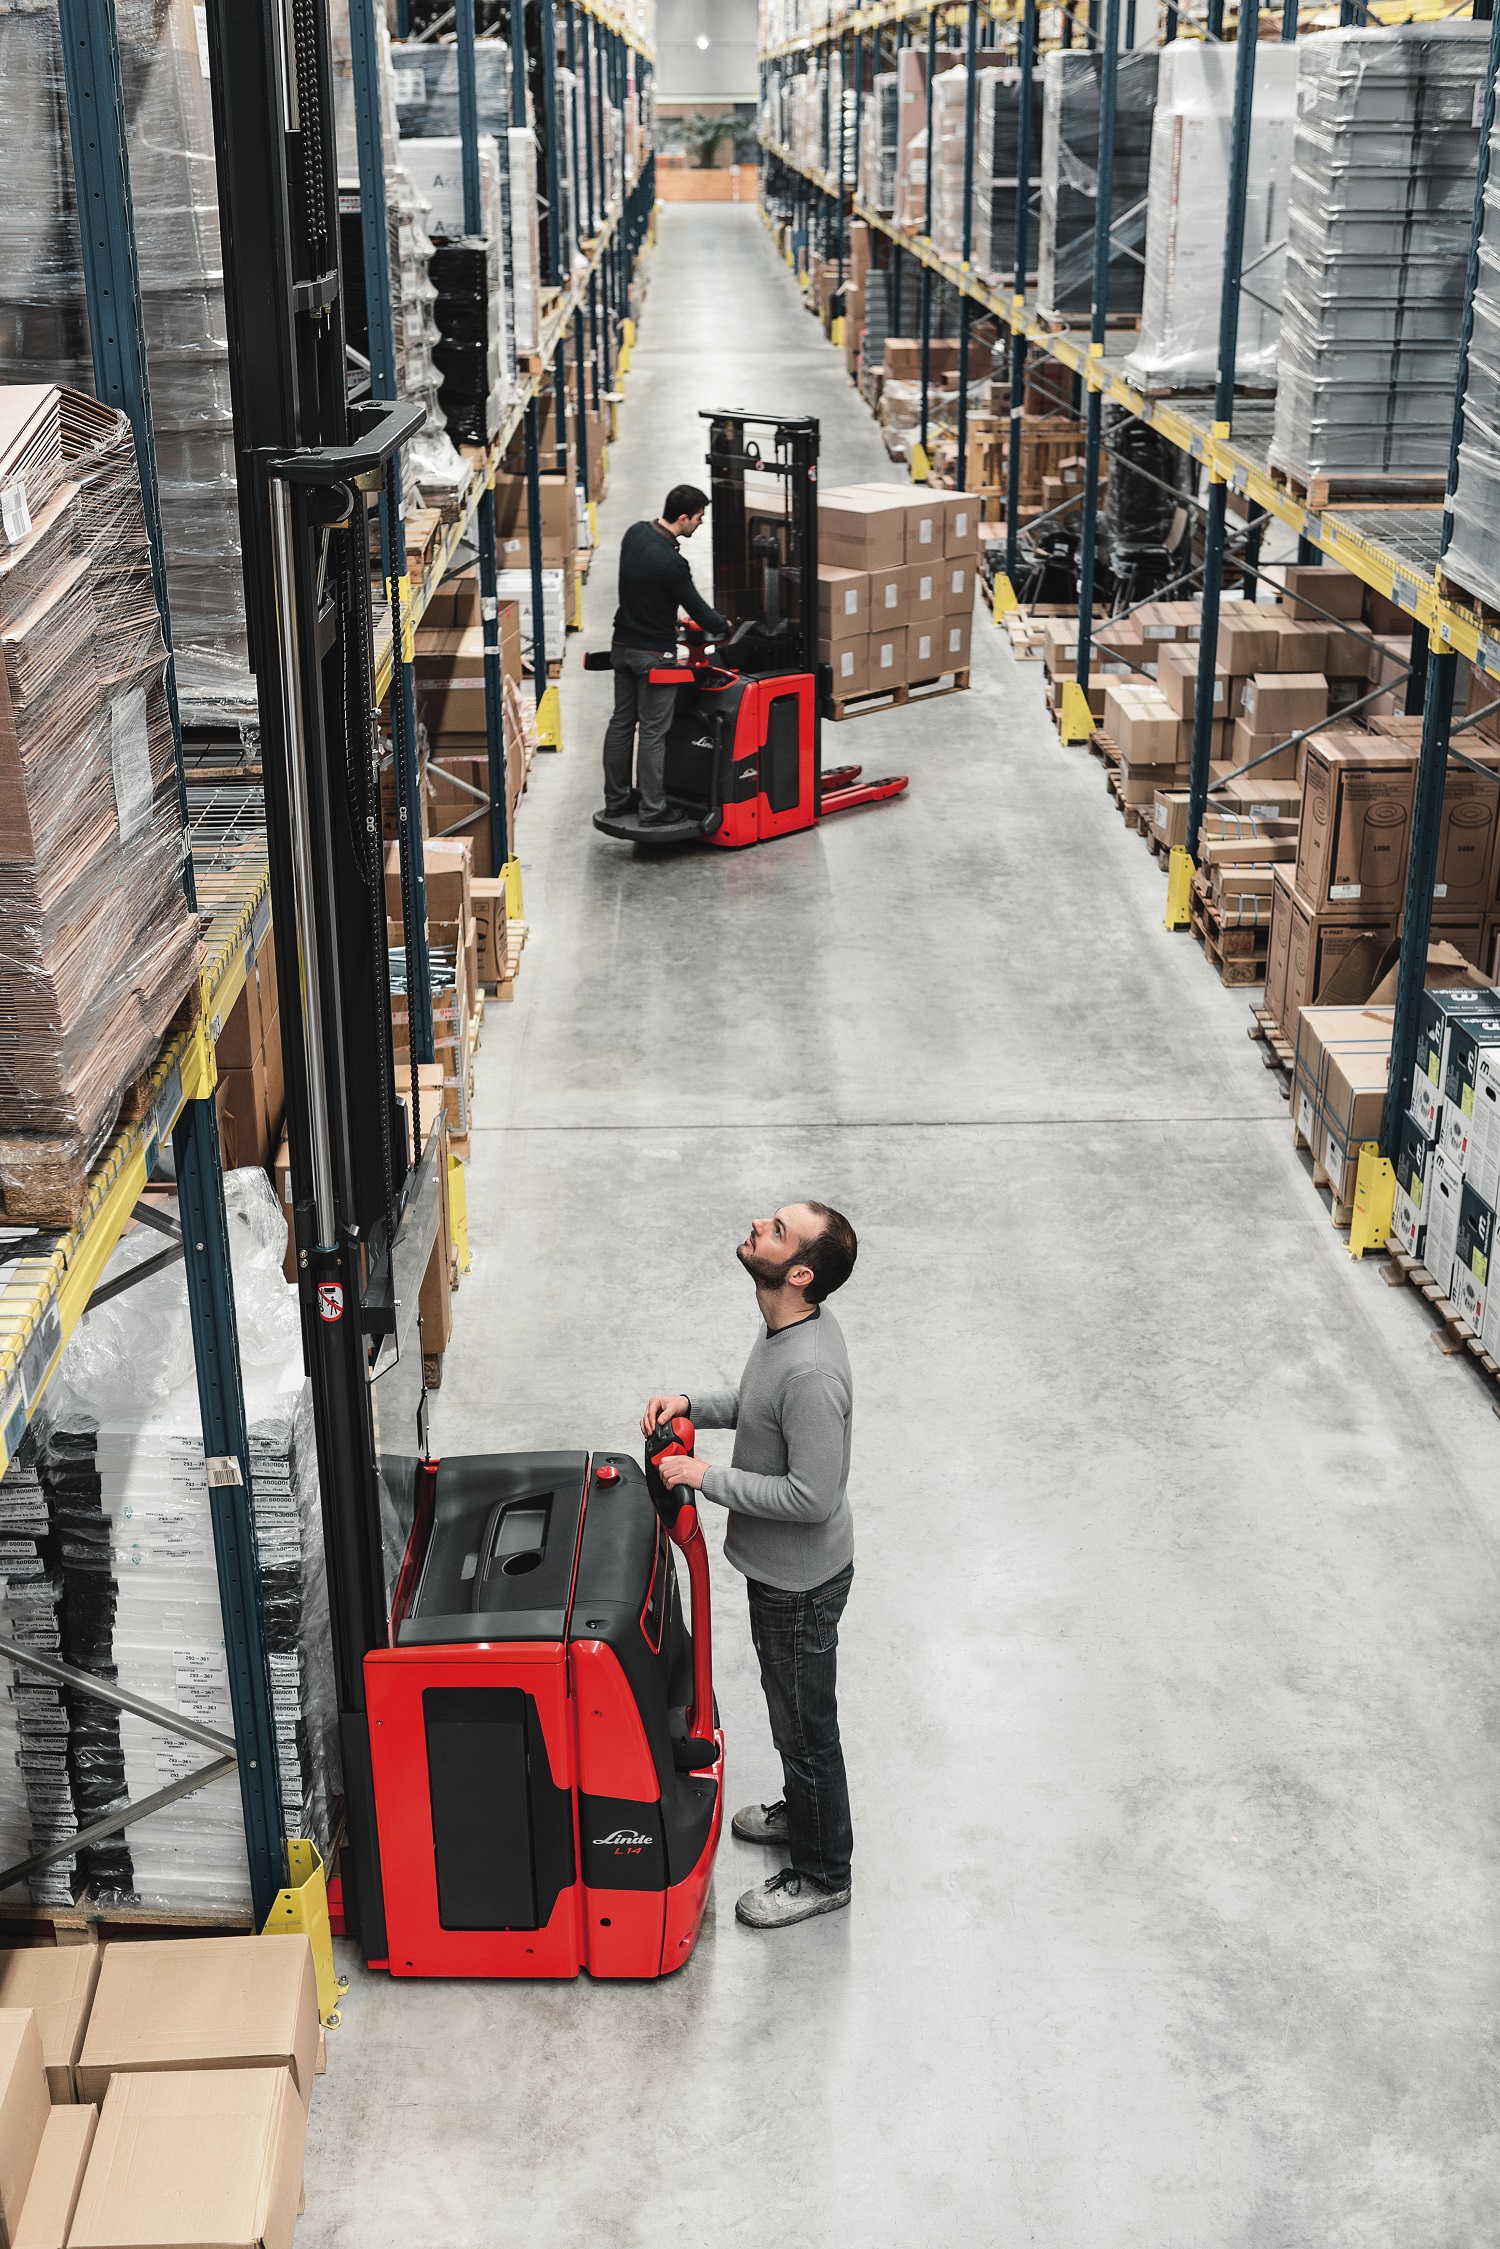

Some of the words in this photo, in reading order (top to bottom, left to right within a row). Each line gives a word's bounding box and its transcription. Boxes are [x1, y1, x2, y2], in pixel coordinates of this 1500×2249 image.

[691, 736, 714, 749] Lin
[592, 1829, 653, 1845] Linde
[626, 1847, 642, 1855] 14
